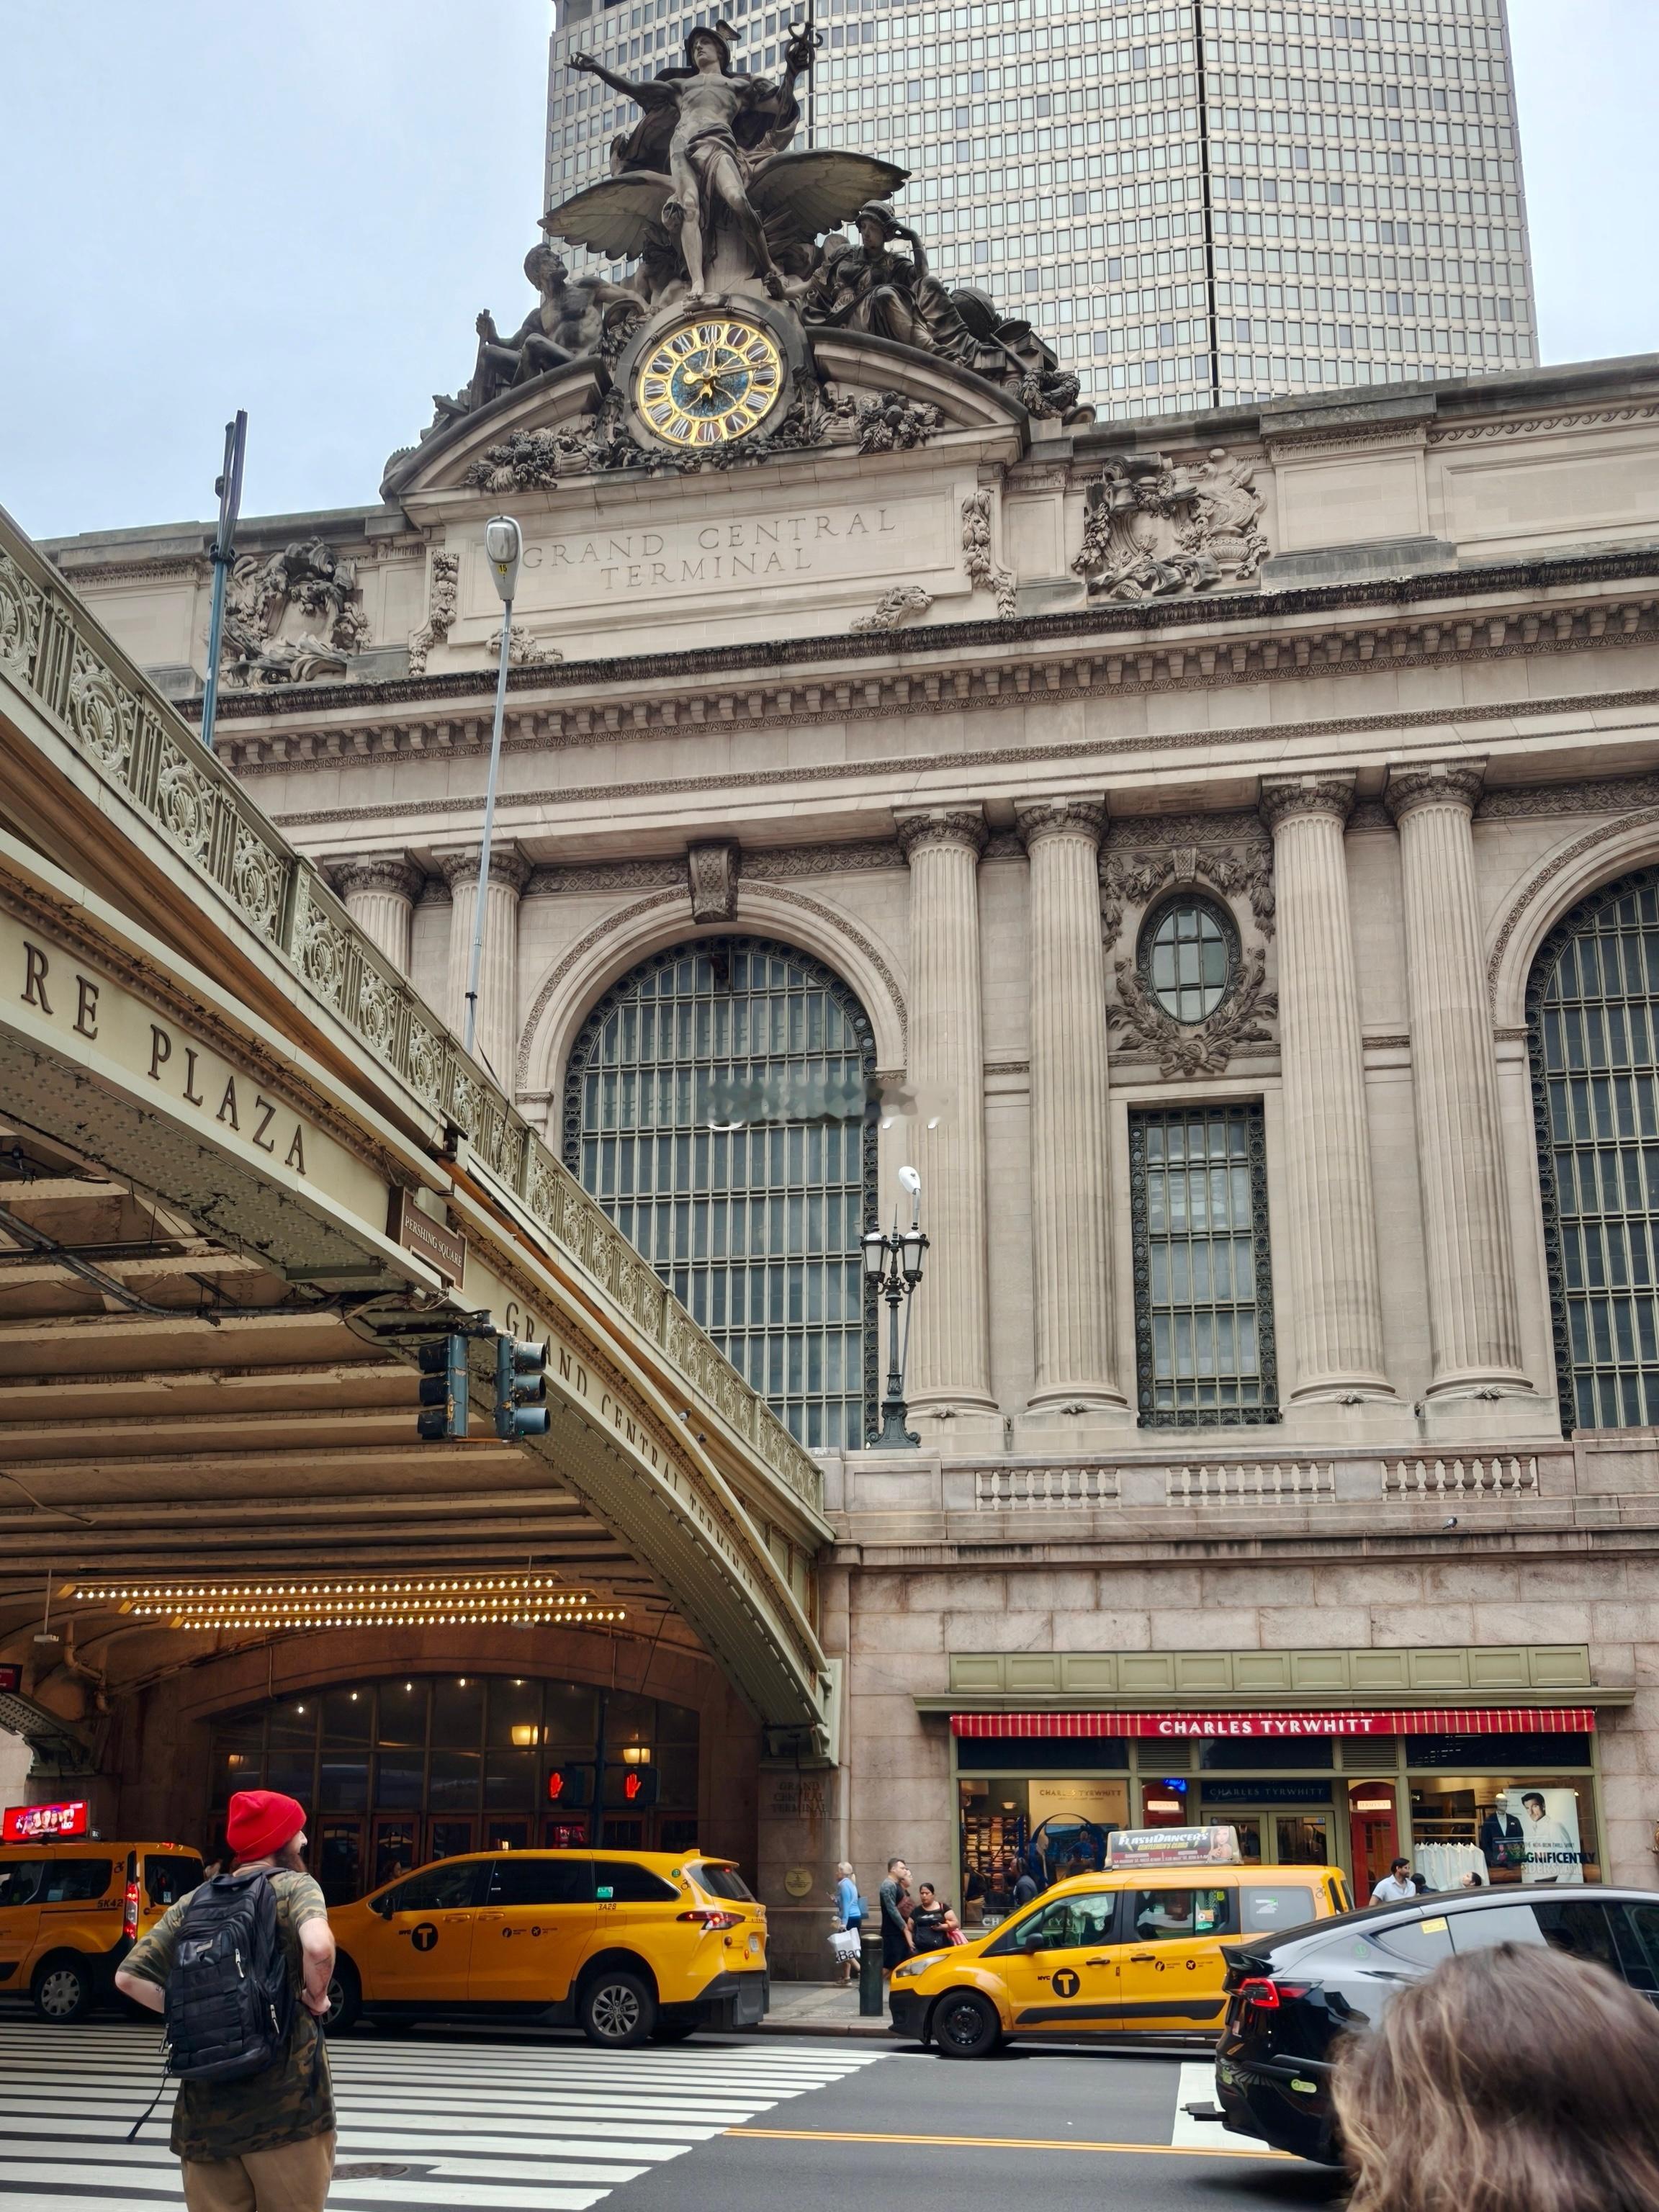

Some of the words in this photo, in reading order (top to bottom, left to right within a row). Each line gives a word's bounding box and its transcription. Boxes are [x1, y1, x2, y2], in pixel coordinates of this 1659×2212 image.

[522, 534, 665, 569] GRAND
[698, 508, 896, 549] CENTRAL
[601, 548, 813, 590] TERMINAL
[148, 1024, 307, 1175] PLAZA
[405, 1215, 437, 1249] PERSHING
[438, 1241, 463, 1268] SQUARE
[601, 1393, 678, 1491] CENTRAL
[1159, 1719, 1251, 1735] CHARLES
[1261, 1719, 1372, 1735] TYRWHITT
[779, 1781, 819, 1791] GRAND
